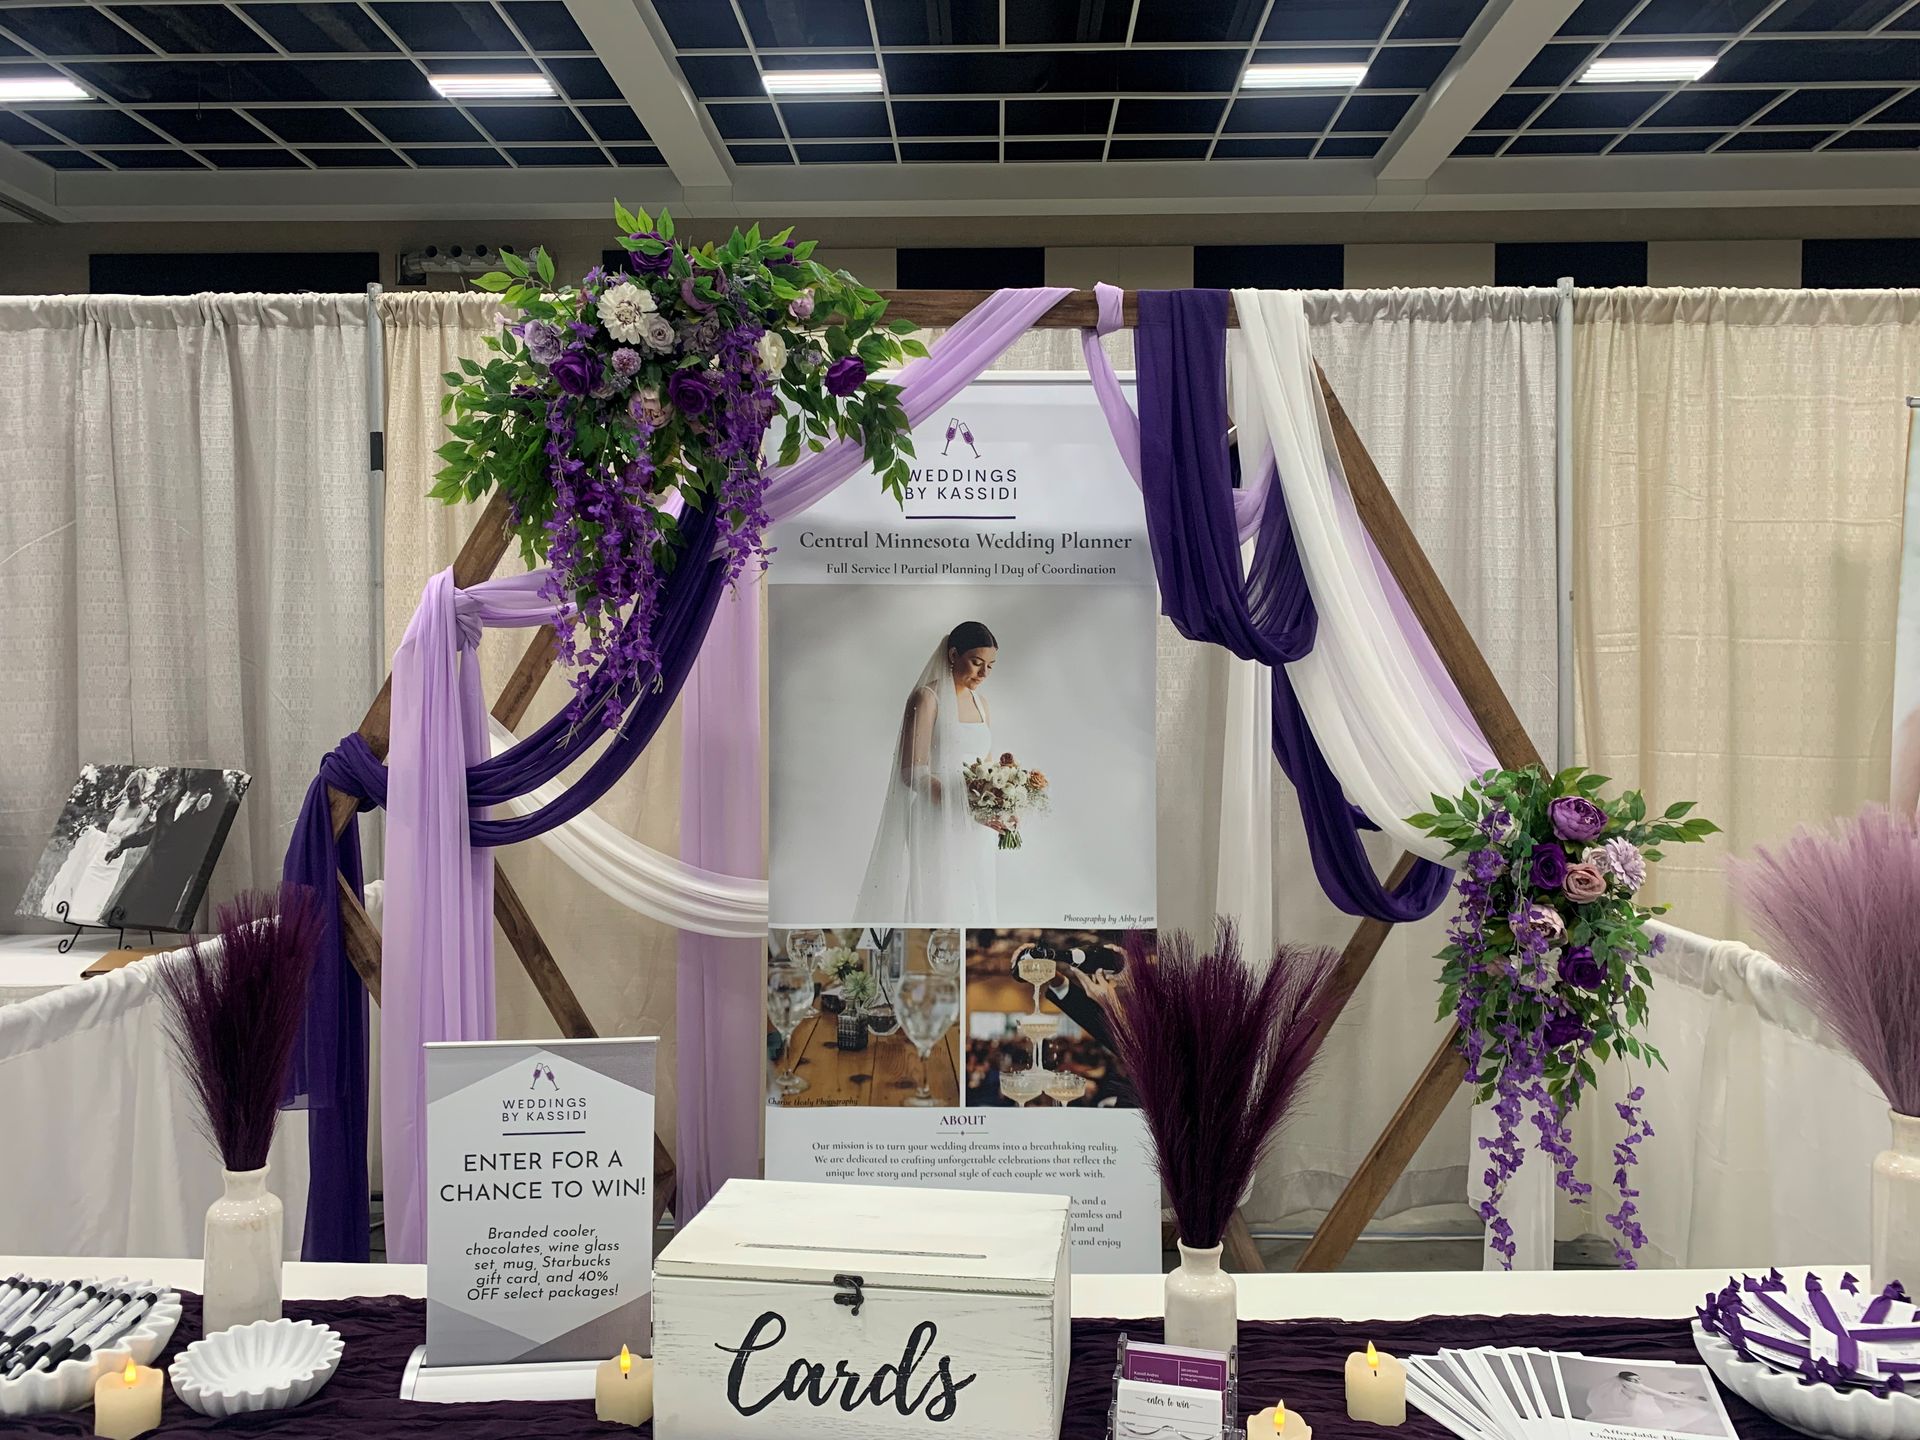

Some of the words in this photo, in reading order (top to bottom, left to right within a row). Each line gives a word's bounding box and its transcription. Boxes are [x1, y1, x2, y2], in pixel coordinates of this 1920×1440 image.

[907, 469, 1017, 483] WEDDINGS
[905, 487, 927, 500] BY
[938, 487, 1018, 500] KASSIDI
[800, 531, 869, 549] Central
[875, 533, 970, 549] Minnesota
[976, 533, 1055, 554] Wedding
[1061, 533, 1132, 549] Planner
[826, 563, 848, 574] Full
[851, 564, 891, 574] Service
[901, 564, 939, 575] Partial
[942, 563, 991, 578] Planning
[1001, 564, 1024, 578] Day
[1027, 563, 1040, 575] of
[1042, 563, 1116, 575] Coordination
[1064, 914, 1106, 924] Photography
[1108, 915, 1117, 924] by
[1119, 915, 1136, 924] Abby
[503, 1098, 587, 1109] WEDDINGS
[502, 1112, 519, 1122] BY
[527, 1111, 587, 1121] KASSIDI
[939, 1115, 986, 1126] ABOUT
[811, 1142, 830, 1151] Our
[832, 1141, 865, 1151] mission
[866, 1141, 874, 1151] is
[875, 1142, 885, 1151] to
[886, 1142, 906, 1151] turn
[907, 1143, 928, 1153] your
[930, 1141, 967, 1153] wedding
[968, 1141, 1000, 1151] dreams
[1002, 1142, 1020, 1151] into
[1030, 1142, 1086, 1153] breathtaking
[1088, 1142, 1119, 1154] reality.
[464, 1153, 542, 1172] ENTER
[552, 1151, 599, 1169] FOR
[608, 1150, 623, 1168] A
[814, 1155, 828, 1164] We
[829, 1156, 845, 1164] are
[846, 1154, 888, 1164] dedicated
[889, 1156, 900, 1164] to
[901, 1154, 936, 1167] crafting
[937, 1154, 996, 1167] unforgettable
[998, 1155, 1051, 1165] celebrations
[1052, 1155, 1071, 1165] that
[1073, 1155, 1101, 1165] reflect
[1102, 1156, 1117, 1166] the
[825, 1169, 856, 1180] unique
[857, 1168, 875, 1178] love
[876, 1170, 899, 1180] story
[901, 1168, 918, 1178] and
[920, 1168, 957, 1181] personal
[958, 1169, 979, 1180] style
[981, 1168, 992, 1178] of
[992, 1169, 1013, 1178] each
[1014, 1169, 1043, 1181] couple
[1059, 1169, 1082, 1178] work
[1083, 1169, 1106, 1178] with.
[440, 1181, 542, 1202] CHANCE
[552, 1180, 582, 1198] TO
[592, 1177, 646, 1197] WIN!
[1082, 1196, 1098, 1205] and
[1070, 1210, 1103, 1218] eamless
[1105, 1210, 1122, 1219] and
[488, 1225, 548, 1239] Branded
[553, 1224, 598, 1240] cooler,
[1087, 1223, 1104, 1232] and
[466, 1242, 543, 1256] chocolates,
[548, 1243, 580, 1253] wine
[584, 1240, 620, 1255] glass
[1078, 1237, 1095, 1246] and
[1097, 1238, 1121, 1248] enjoy
[474, 1258, 497, 1271] set,
[503, 1260, 537, 1272] mug,
[542, 1255, 611, 1268] Starbucks
[477, 1271, 502, 1288] gift
[506, 1274, 540, 1286] card,
[546, 1271, 573, 1283] and
[578, 1270, 608, 1282] 40%
[467, 1288, 499, 1300] OFF
[503, 1287, 544, 1300] select
[548, 1284, 619, 1300] packages!
[715, 1311, 977, 1421] Cards
[1147, 1396, 1164, 1406] enter
[1167, 1398, 1173, 1407] to
